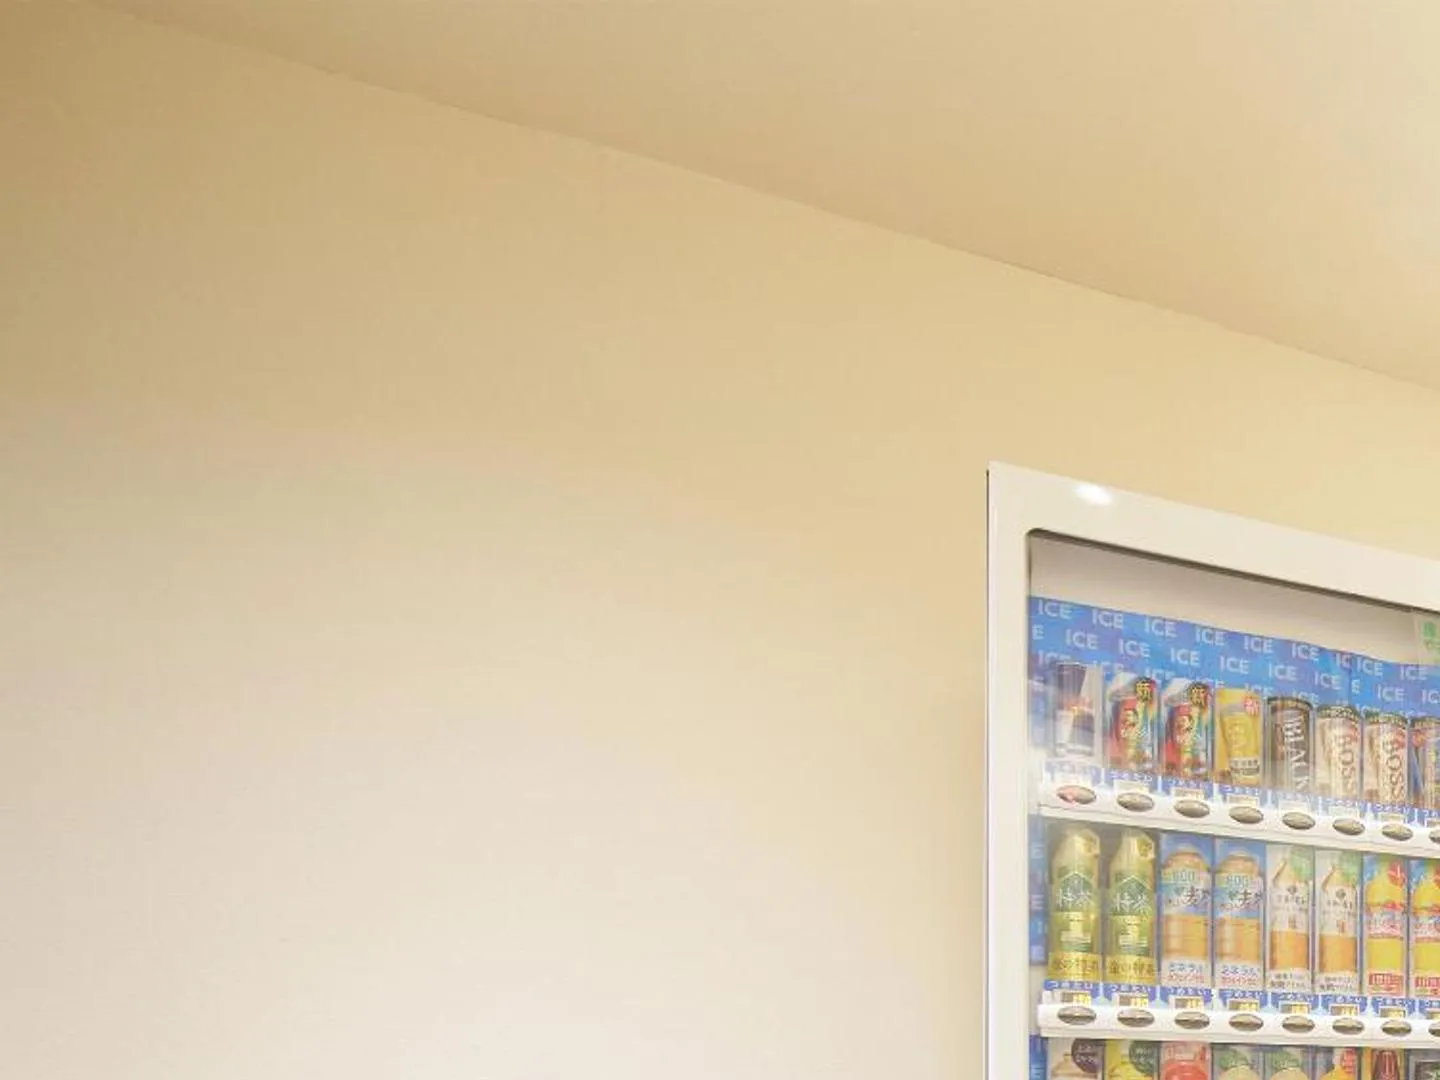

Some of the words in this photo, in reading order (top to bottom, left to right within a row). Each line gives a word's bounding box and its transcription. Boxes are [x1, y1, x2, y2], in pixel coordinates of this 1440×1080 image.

[1038, 599, 1072, 619] ICE
[1092, 609, 1124, 629] ICE
[1145, 618, 1177, 638] ICE
[1194, 627, 1226, 646] ICE
[1244, 636, 1273, 653] ICE
[1292, 643, 1320, 661] ICE
[1336, 652, 1350, 668] IC
[1065, 629, 1099, 650] ICE
[1119, 638, 1150, 657] ICE
[1171, 648, 1200, 666] ICE
[1220, 657, 1249, 674] ICE
[1269, 663, 1297, 681] ICE
[1315, 671, 1342, 689] ICE
[1357, 656, 1383, 676] ICE
[1401, 666, 1428, 680] ICE
[1378, 684, 1405, 701] ICE
